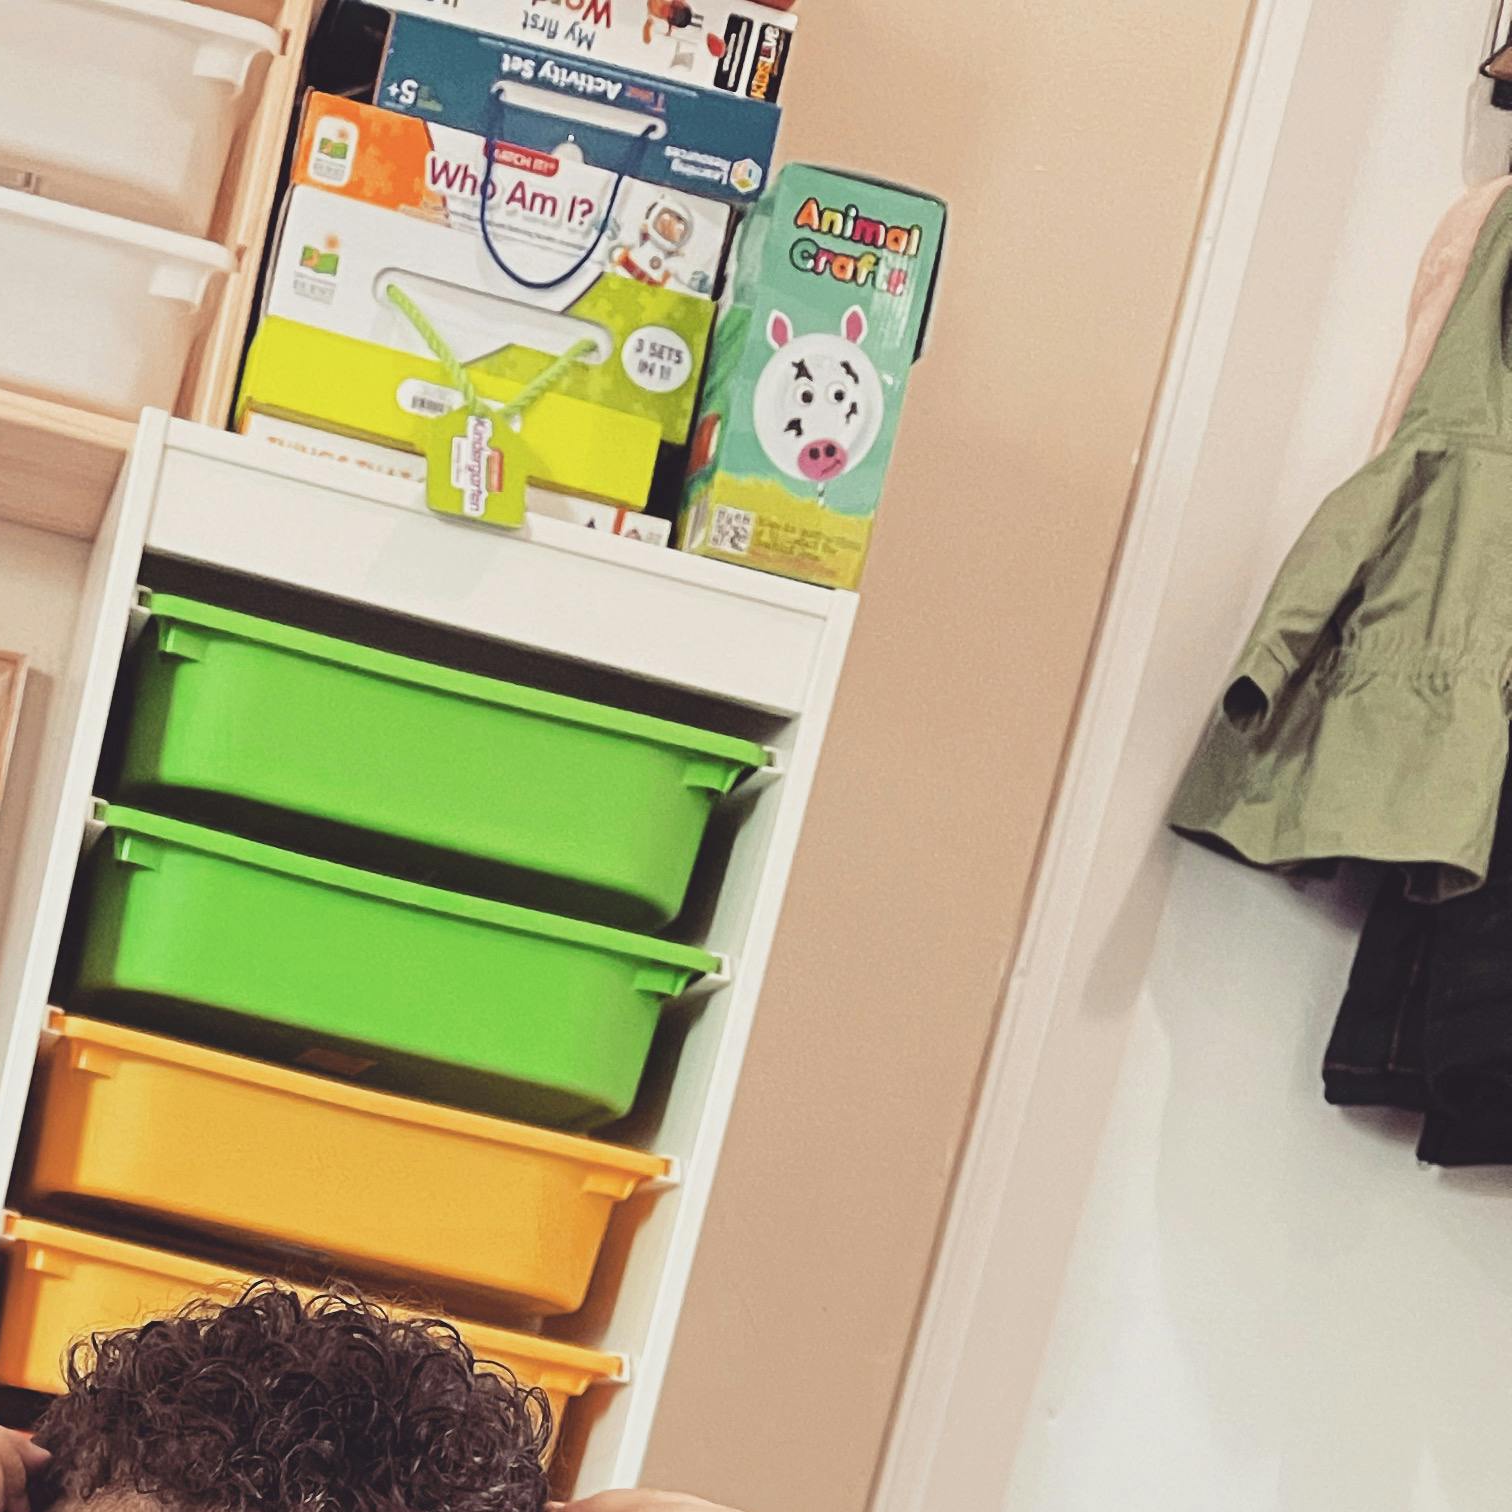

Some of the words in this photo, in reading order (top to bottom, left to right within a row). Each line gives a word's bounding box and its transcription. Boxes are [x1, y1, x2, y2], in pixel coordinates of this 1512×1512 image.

[522, 10, 559, 39] first
[565, 21, 596, 50] My
[501, 53, 536, 79] Set
[537, 59, 622, 101] Activity
[387, 79, 419, 105] 5+
[430, 157, 497, 201] Who
[505, 181, 558, 218] Am
[567, 195, 595, 226] I?
[793, 197, 923, 257] Animal
[648, 342, 683, 364] SETS
[468, 417, 487, 513] Kindergarten
